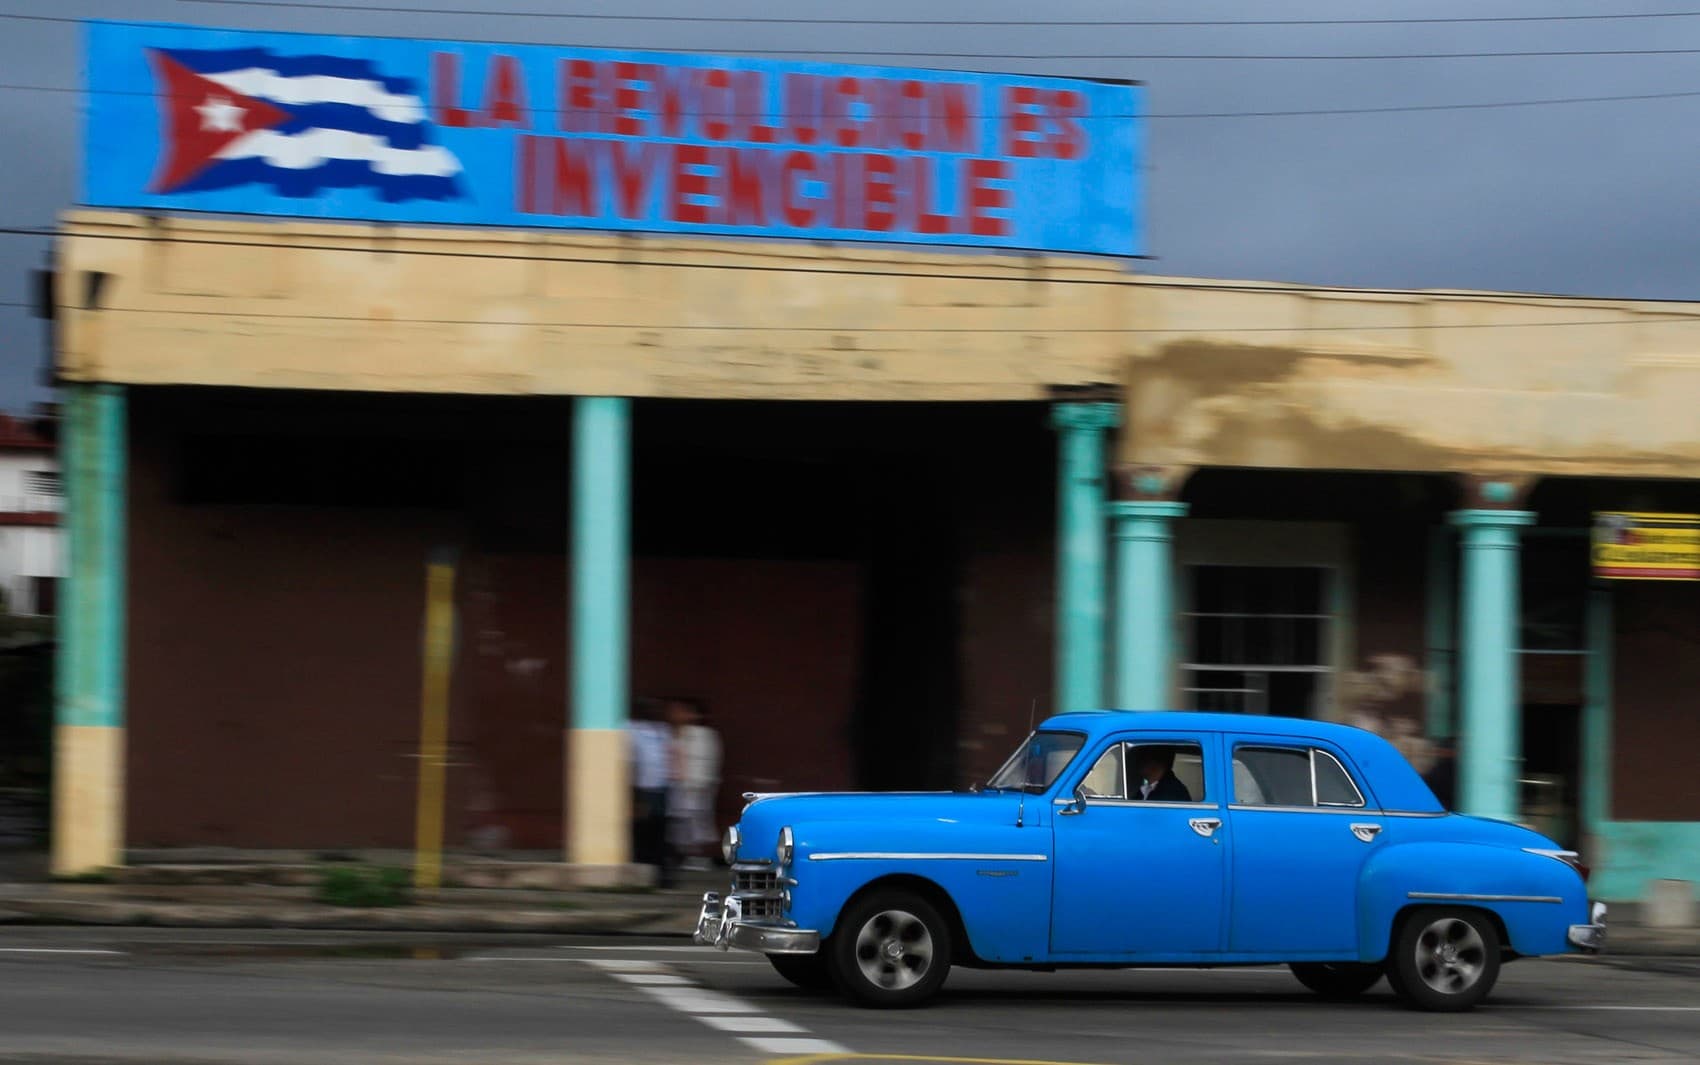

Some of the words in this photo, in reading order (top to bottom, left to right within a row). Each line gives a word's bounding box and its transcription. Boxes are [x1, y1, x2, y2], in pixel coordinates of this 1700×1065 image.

[430, 52, 527, 129] LA
[561, 59, 980, 154] REVOLUCION
[1003, 86, 1087, 160] ES
[516, 134, 1013, 236] INVENCIBLE
